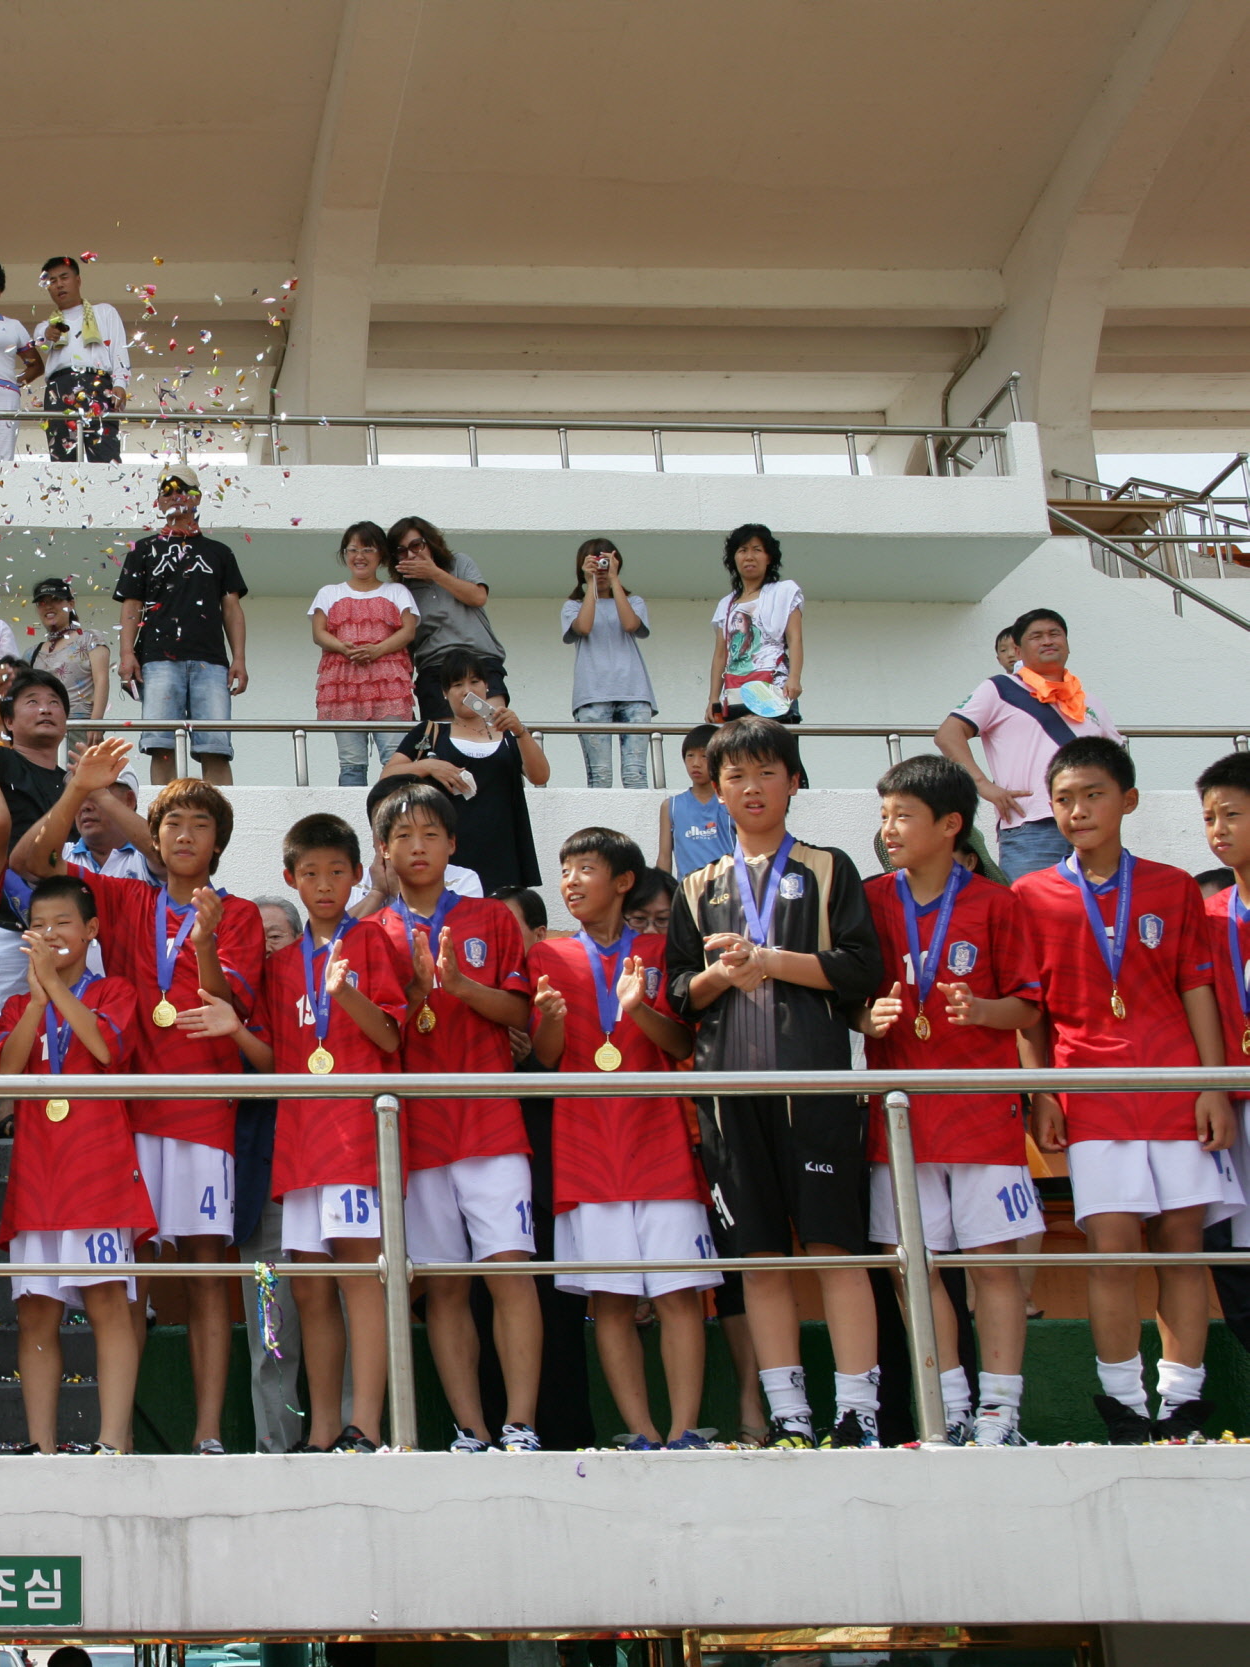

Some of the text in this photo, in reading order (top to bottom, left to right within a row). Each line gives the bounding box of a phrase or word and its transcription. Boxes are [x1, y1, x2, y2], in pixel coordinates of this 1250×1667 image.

[199, 1186, 217, 1220] 4
[339, 1188, 369, 1224] 15
[996, 1182, 1029, 1222] 10
[84, 1231, 118, 1264] 18
